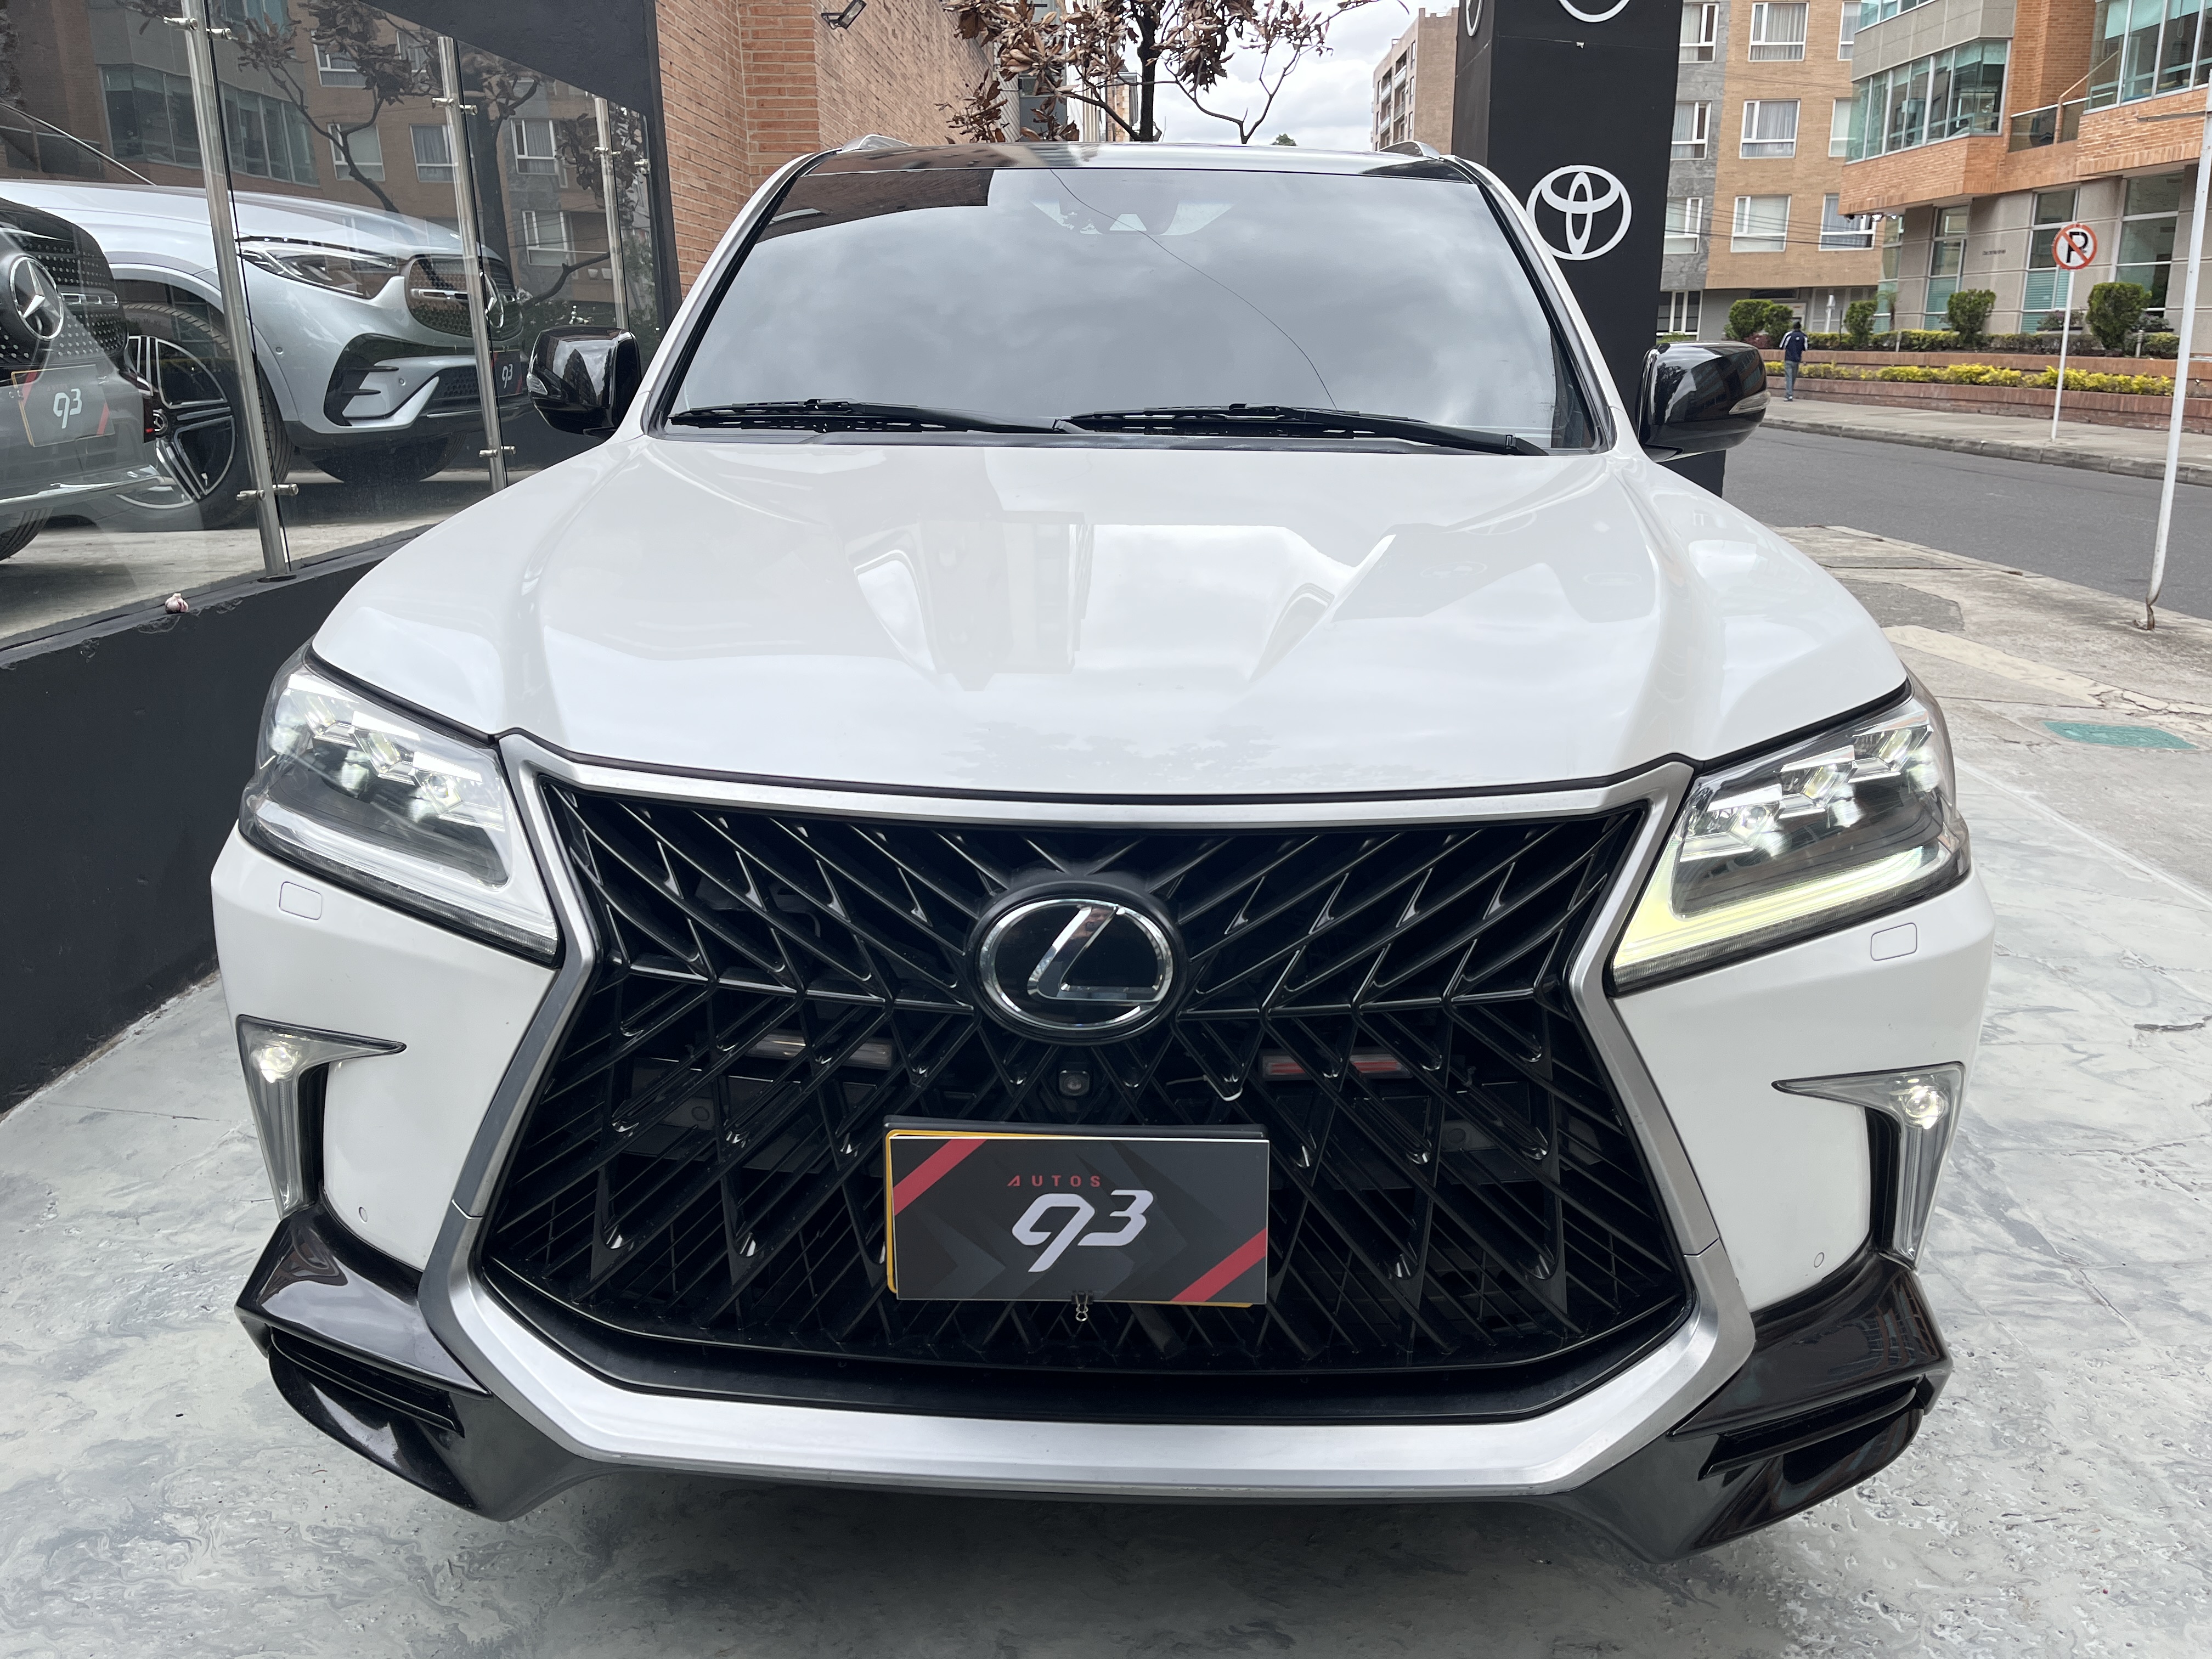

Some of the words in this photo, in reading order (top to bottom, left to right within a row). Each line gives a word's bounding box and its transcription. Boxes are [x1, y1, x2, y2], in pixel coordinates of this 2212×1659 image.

[2066, 232, 2088, 263] P
[501, 364, 513, 389] 93
[53, 388, 82, 429] 93
[1007, 1175, 1101, 1187] AUTOS
[1012, 1189, 1154, 1273] 93
